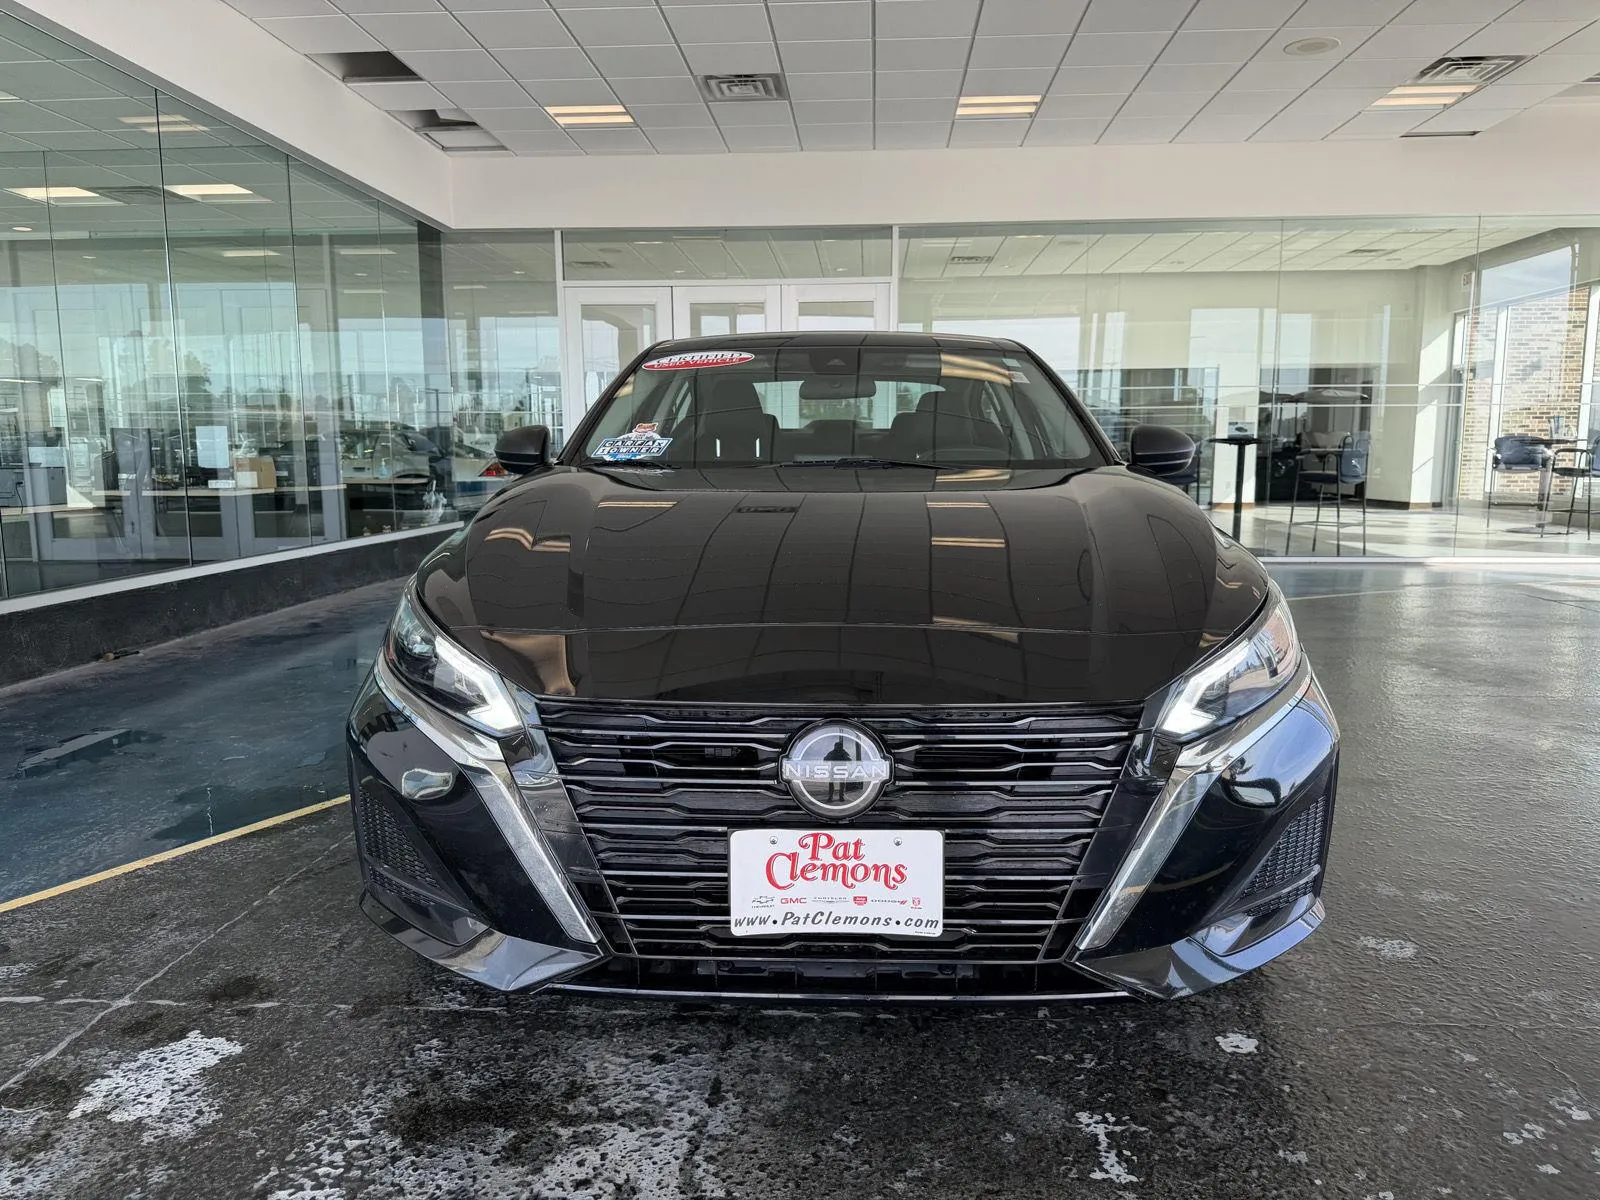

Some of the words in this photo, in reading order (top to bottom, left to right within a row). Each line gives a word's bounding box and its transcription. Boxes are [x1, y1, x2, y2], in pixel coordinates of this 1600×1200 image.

[654, 360, 685, 368] USED
[688, 356, 740, 365] VEHICLE
[785, 763, 886, 779] NISSAN
[798, 832, 866, 862] Pat
[765, 852, 908, 891] Clemons
[780, 897, 807, 905] GMC
[734, 910, 939, 929] www.PatClemons.com
